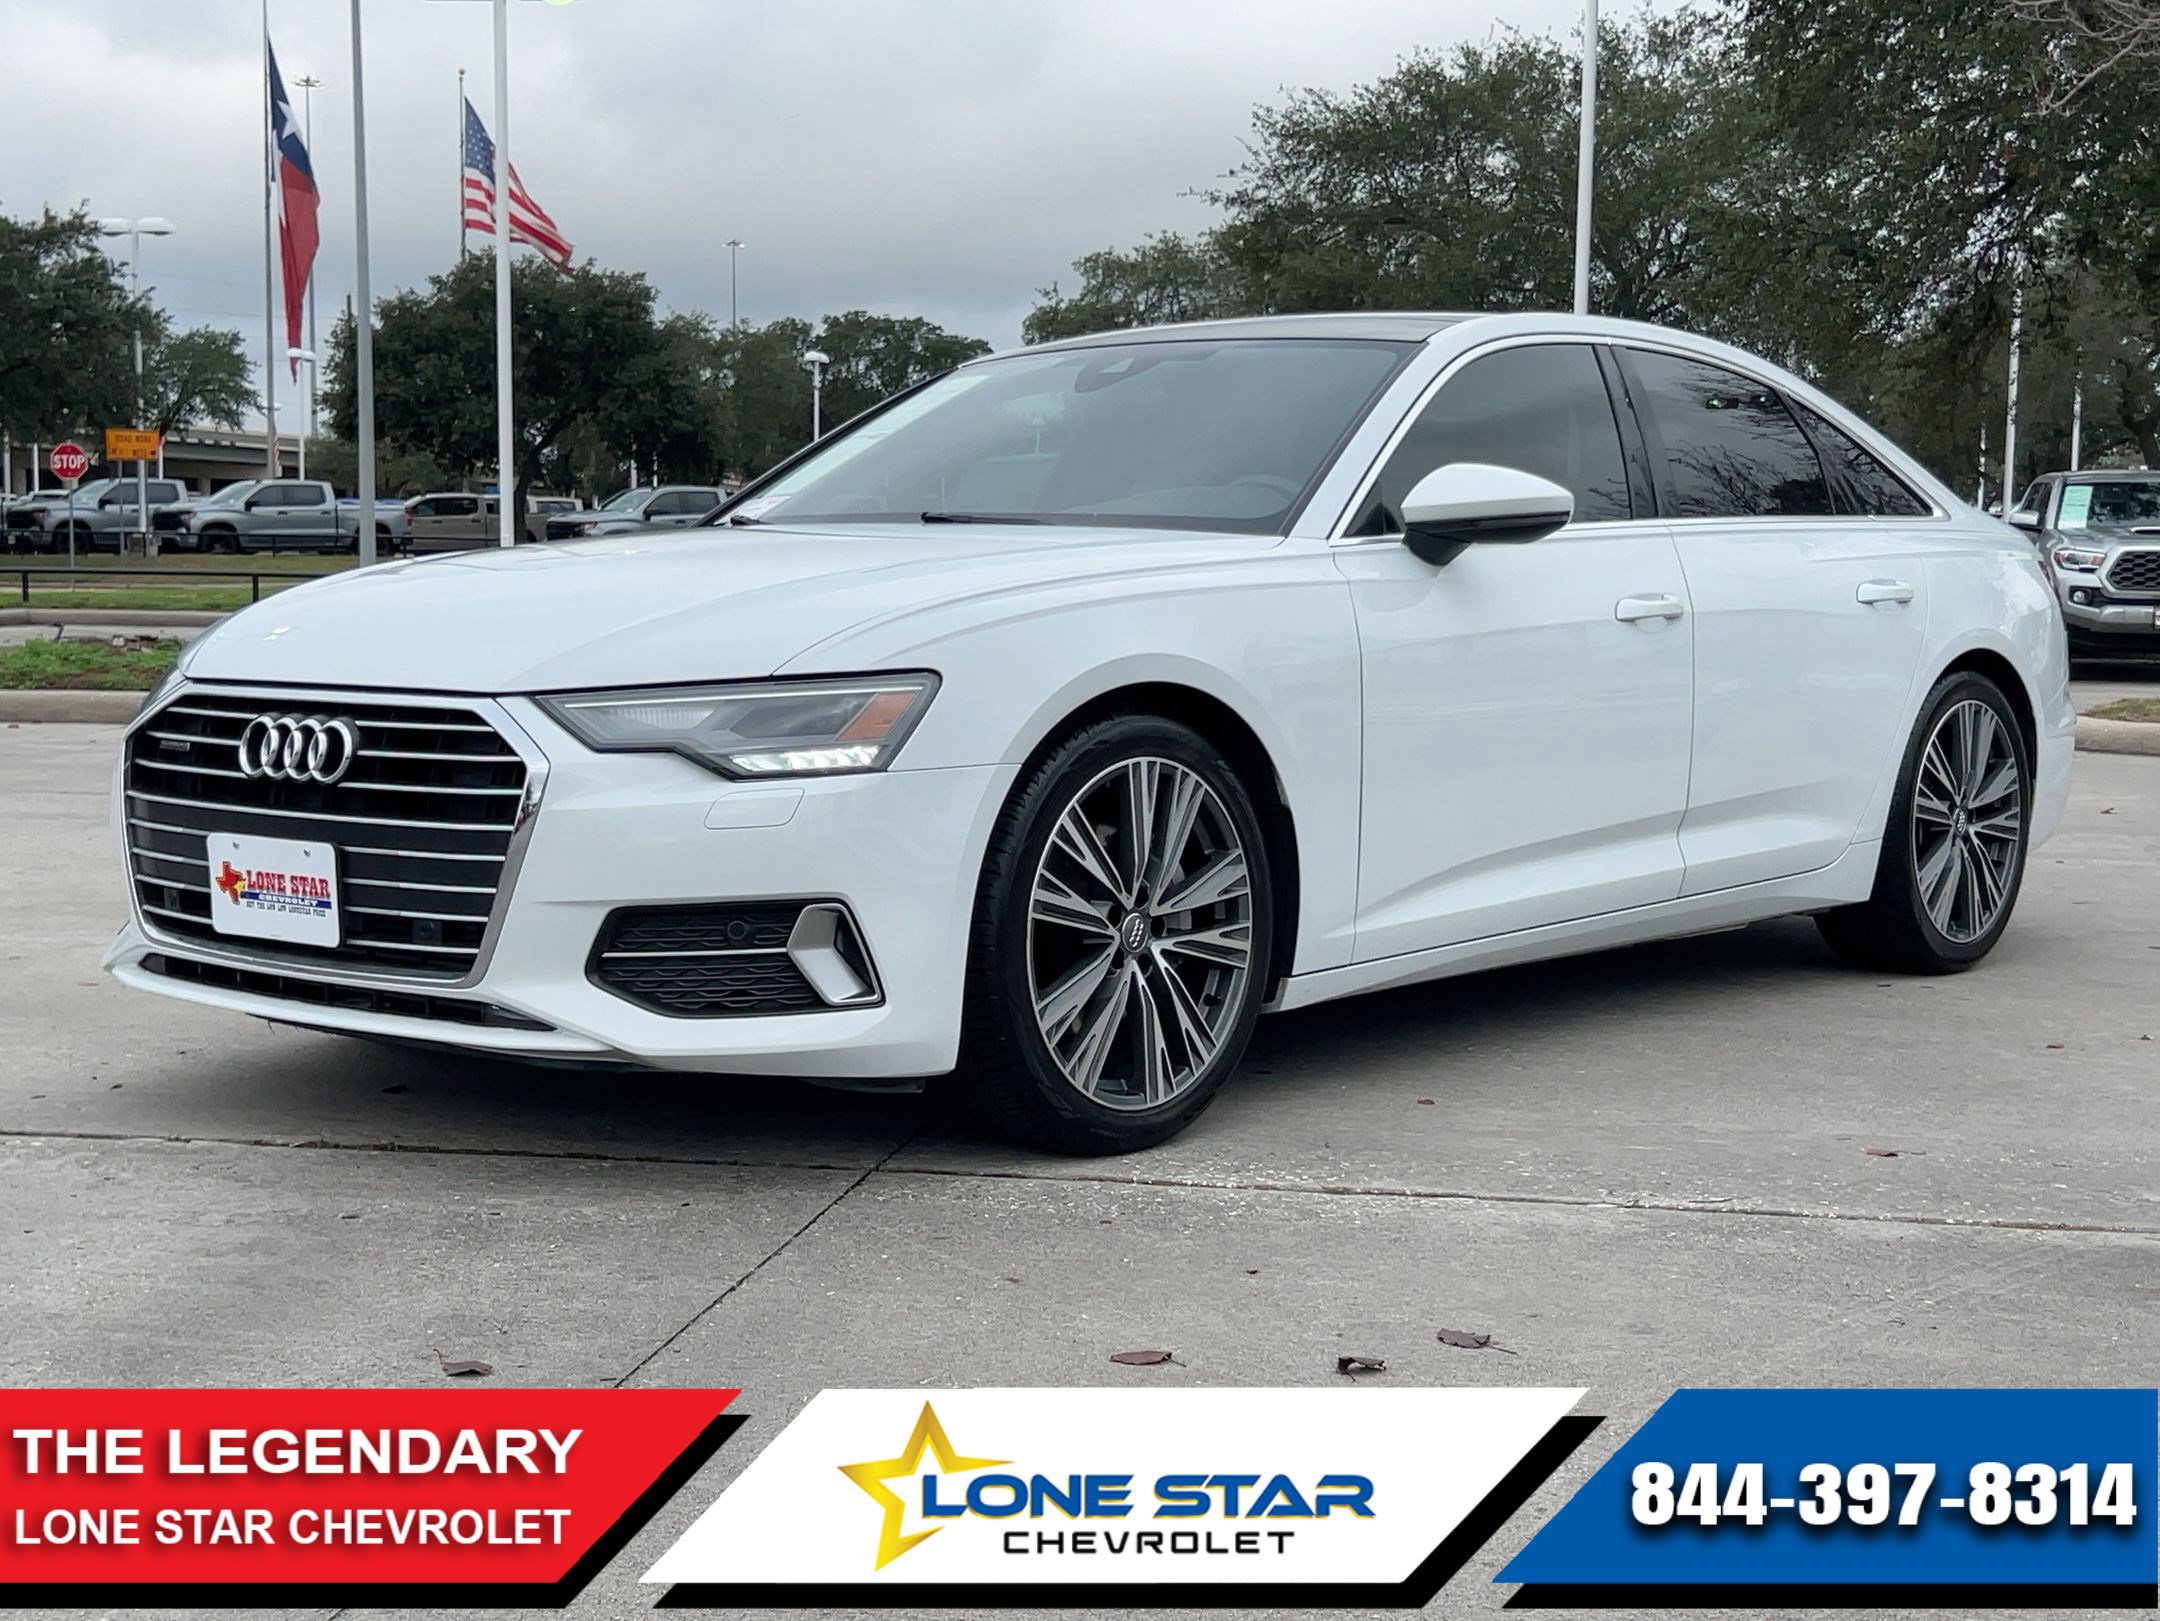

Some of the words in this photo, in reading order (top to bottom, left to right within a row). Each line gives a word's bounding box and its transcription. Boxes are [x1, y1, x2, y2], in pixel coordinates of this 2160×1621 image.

[53, 454, 86, 469] STOP
[246, 870, 287, 893] LONE
[290, 875, 331, 899] STAR
[258, 893, 318, 907] CHEVROLET
